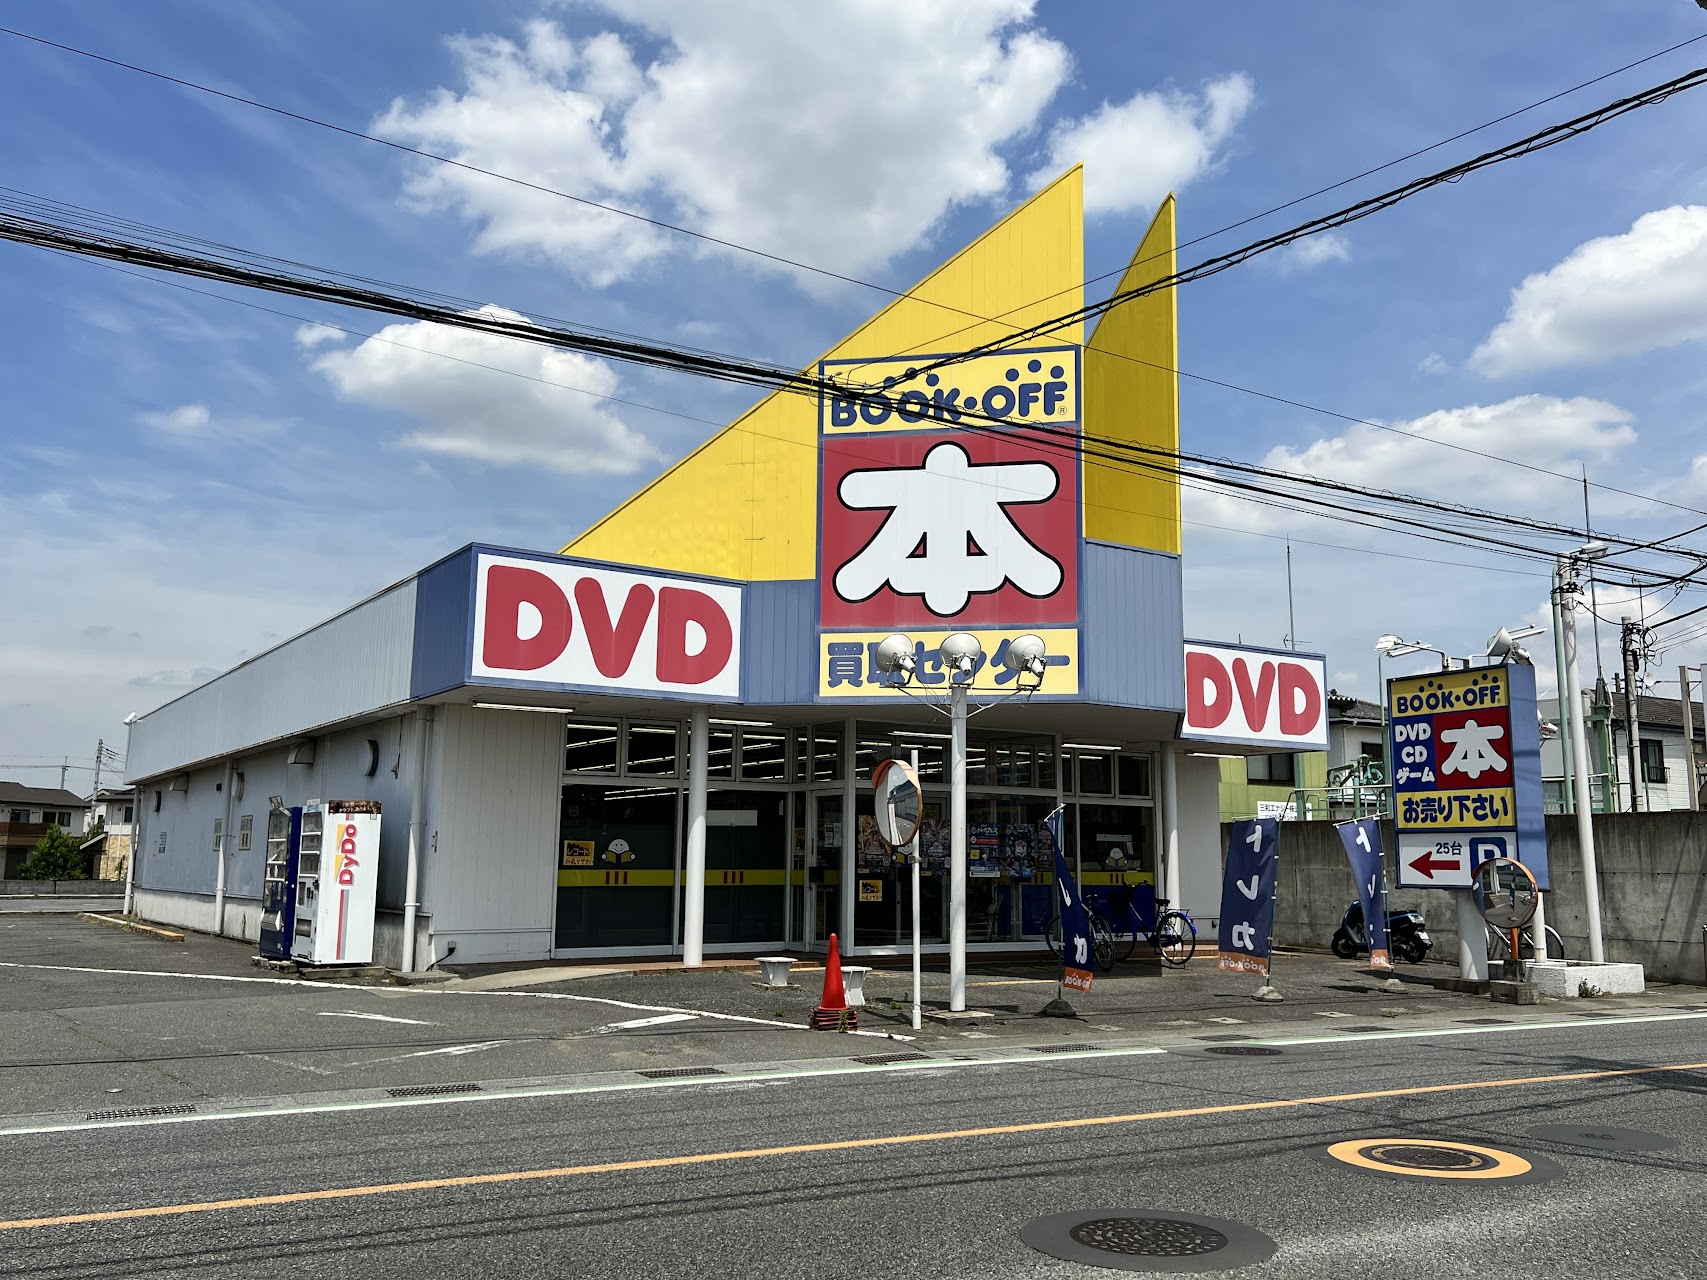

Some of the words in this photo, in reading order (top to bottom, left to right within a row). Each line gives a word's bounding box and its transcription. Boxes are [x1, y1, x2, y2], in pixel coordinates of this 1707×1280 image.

[834, 441, 1064, 618] 本
[483, 565, 733, 685] DVD
[1186, 651, 1321, 736] DVD
[1394, 722, 1432, 743] DVD
[1401, 745, 1428, 764] CD
[1440, 719, 1508, 780] 本
[1396, 767, 1436, 785] ゲーム
[1260, 803, 1311, 814] 三和エナジー株
[1402, 793, 1509, 823] お売り下さい
[338, 823, 359, 885] DyDo
[1436, 841, 1463, 856] 25台
